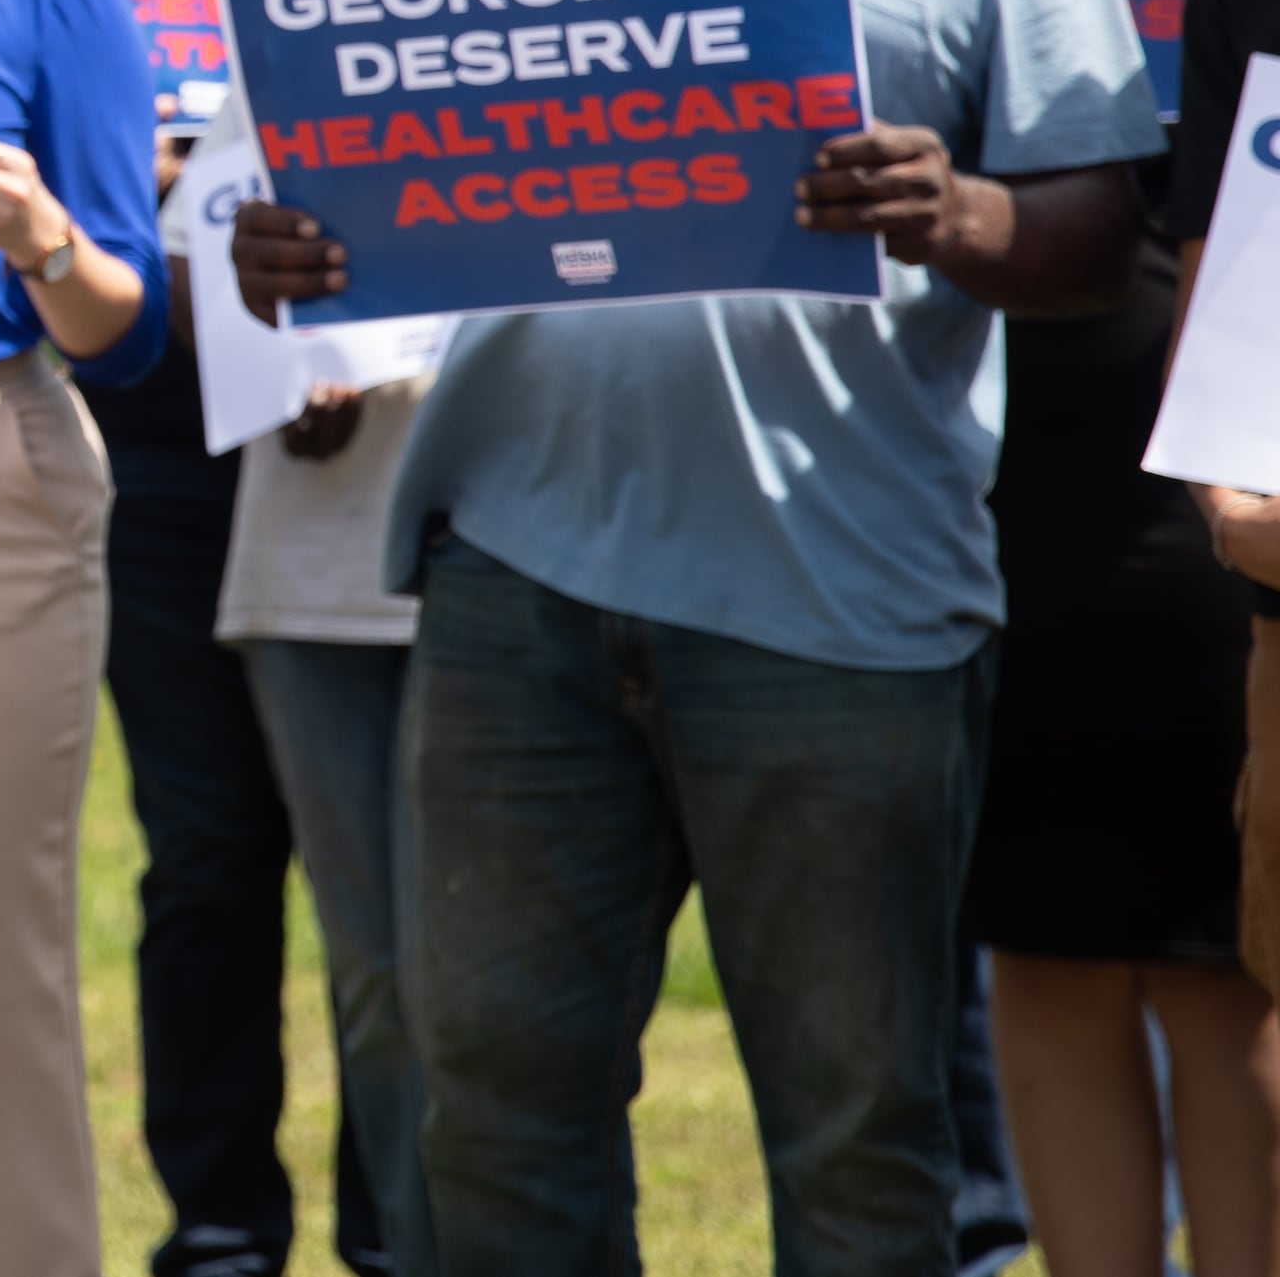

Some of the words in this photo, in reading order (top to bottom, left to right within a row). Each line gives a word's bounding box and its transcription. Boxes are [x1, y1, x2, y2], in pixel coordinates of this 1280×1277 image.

[335, 5, 750, 97] DESERVE
[259, 73, 860, 170] HEALTHCARE
[394, 154, 750, 227] ACCESS
